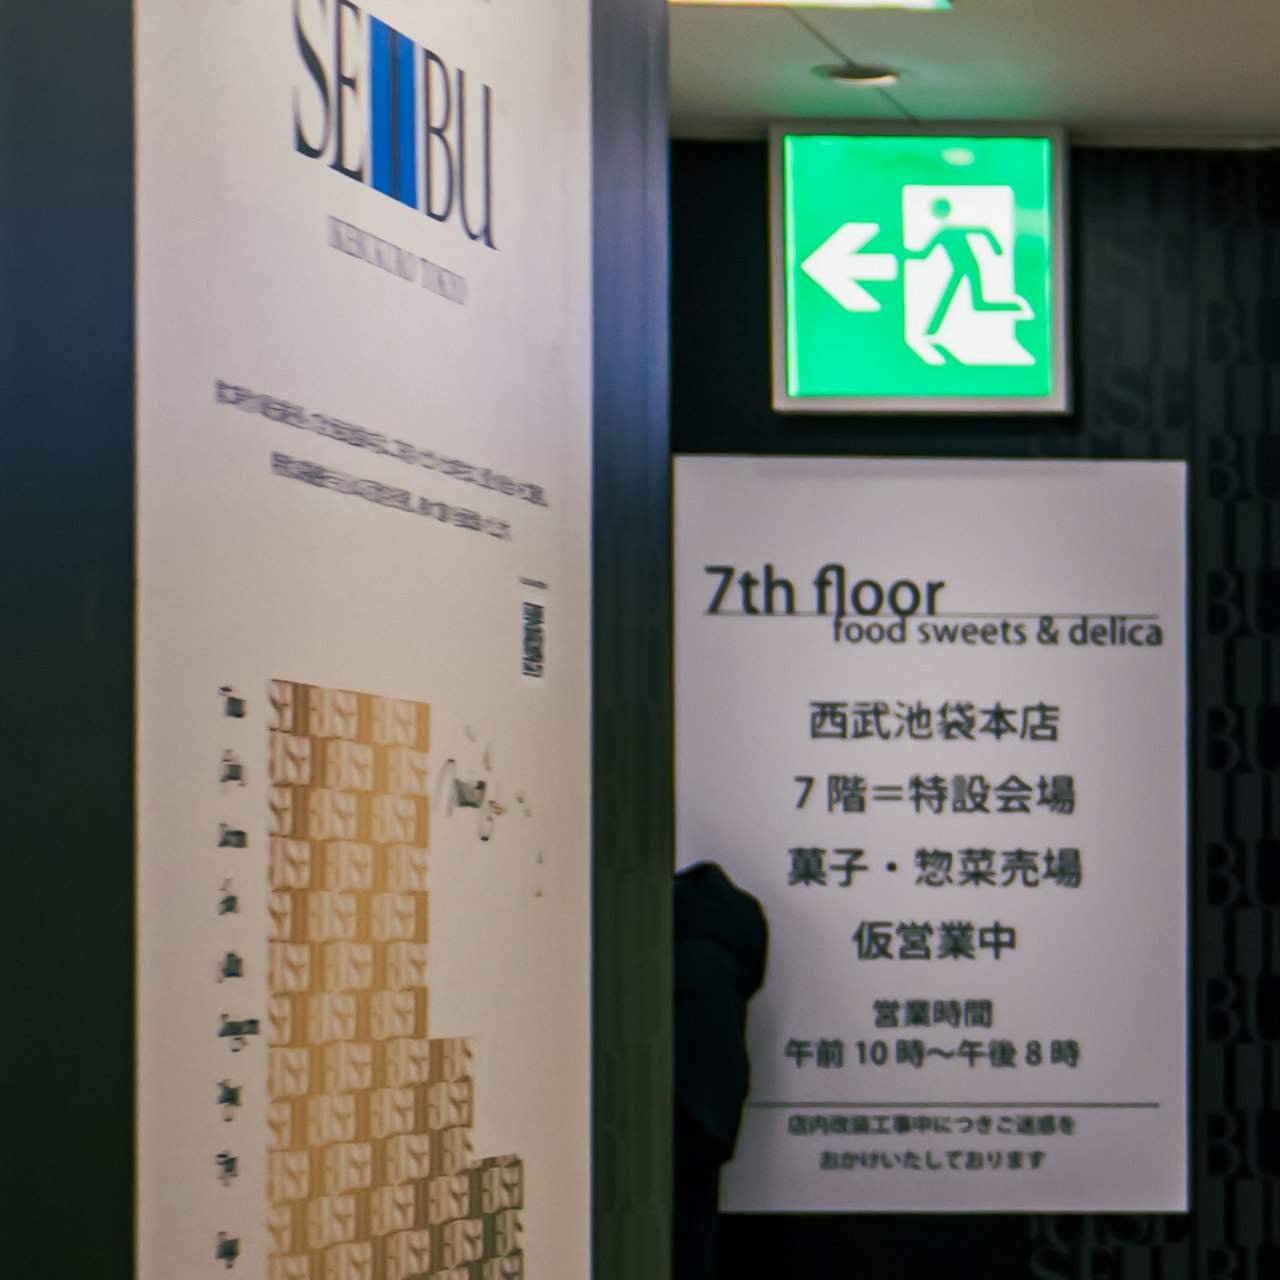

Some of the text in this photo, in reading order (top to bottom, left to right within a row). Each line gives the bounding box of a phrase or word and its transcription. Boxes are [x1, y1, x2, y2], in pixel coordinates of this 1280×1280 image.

[705, 563, 946, 617] 7th floor
[833, 615, 1164, 647] food sweets & delica
[808, 701, 1061, 741] 西武池袋本店
[787, 846, 1083, 889] 菓子・惣菜売場
[853, 919, 1017, 962] 仮営業中
[872, 998, 994, 1029] 営業時間
[818, 1149, 1047, 1173] おかけいたしております
